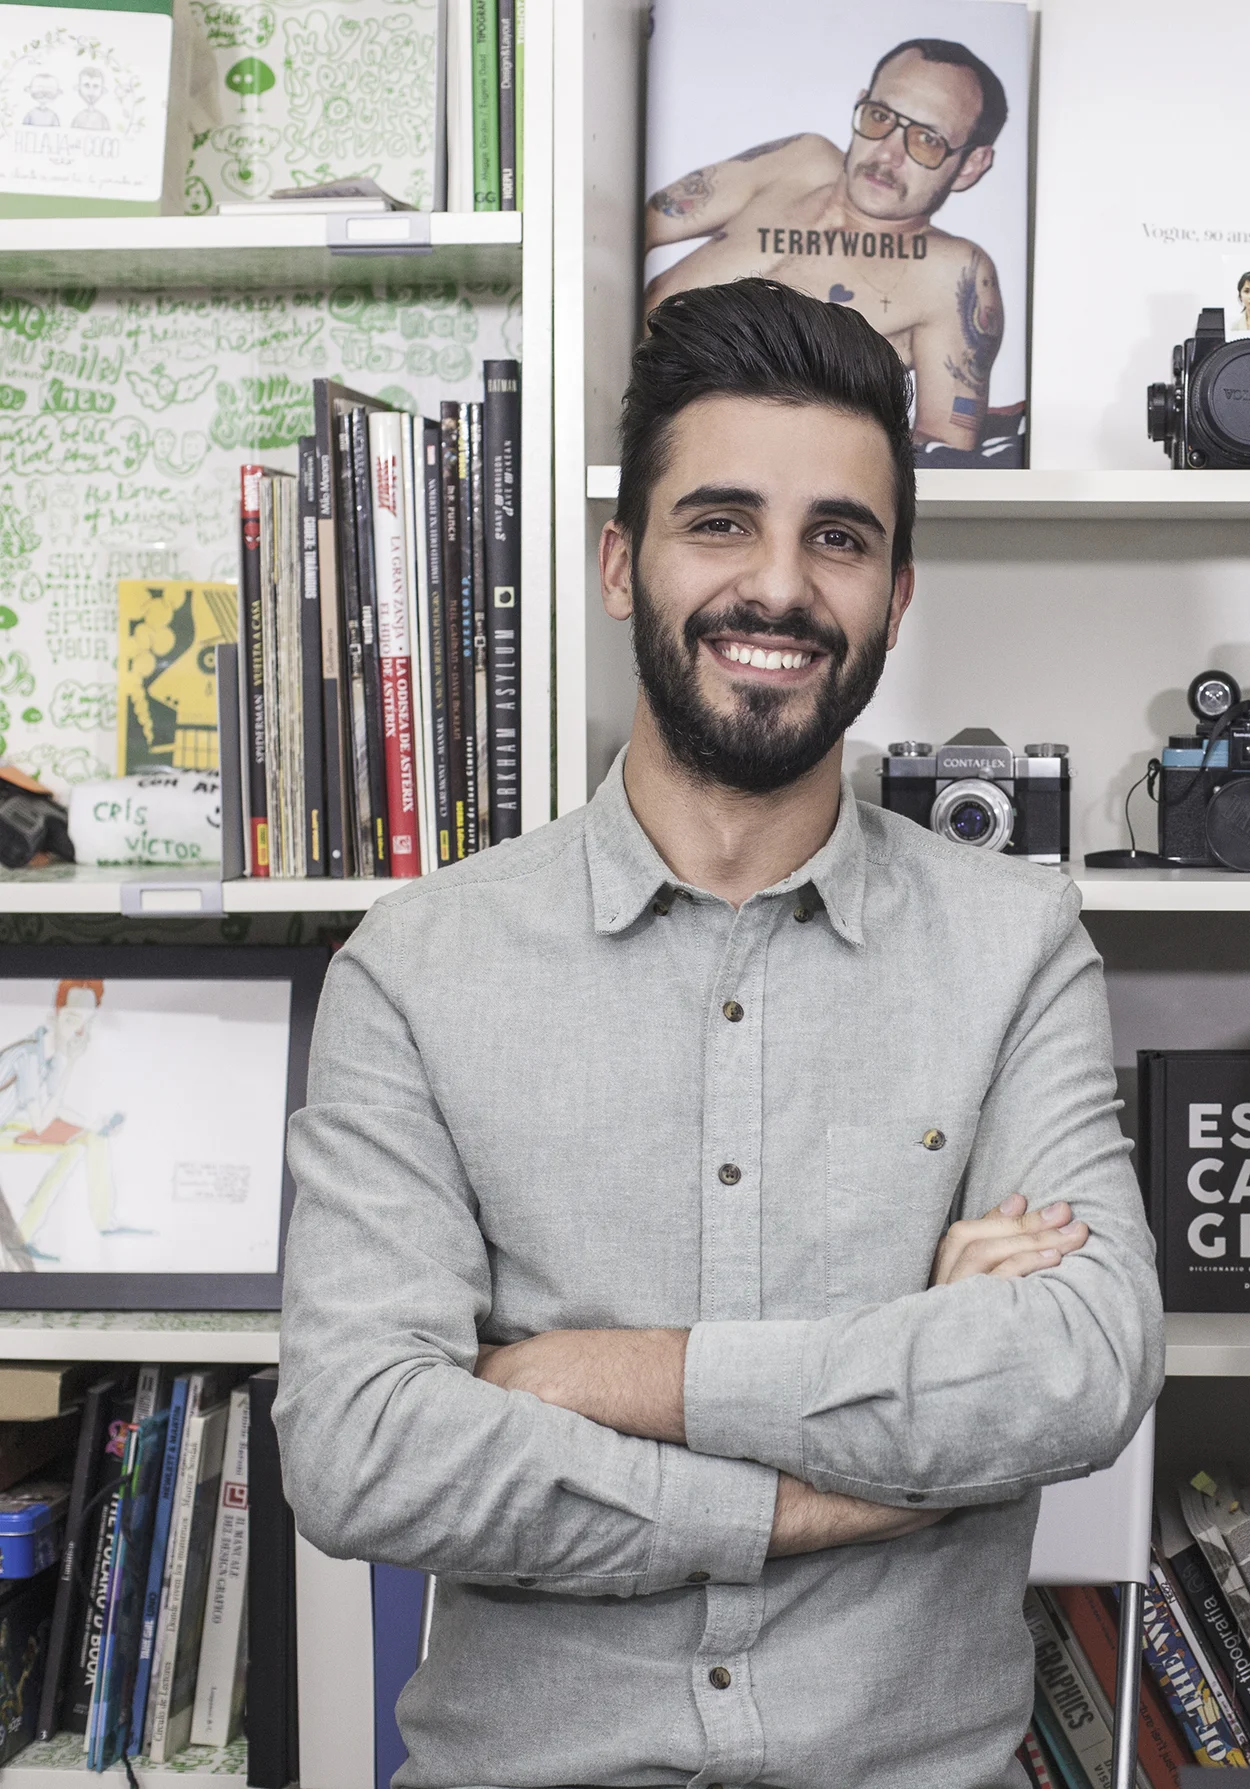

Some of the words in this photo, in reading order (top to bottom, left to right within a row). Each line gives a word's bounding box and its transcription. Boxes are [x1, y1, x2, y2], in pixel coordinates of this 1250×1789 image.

[474, 191, 497, 204] GG
[757, 227, 928, 260] TERRYWORLD
[487, 378, 517, 393] BATMAN
[320, 454, 331, 492] Manara
[320, 495, 331, 515] Milo
[447, 506, 456, 542] PUNCH
[391, 556, 402, 593] GRAN
[251, 599, 262, 631] CASA
[252, 641, 263, 687] VUELTA
[382, 658, 394, 676] DE
[395, 658, 408, 676] LA
[494, 629, 516, 710] ASYLUM
[396, 680, 411, 731] ODISEA
[254, 694, 266, 765] SPIDERMAN
[399, 732, 412, 751] DE
[495, 728, 518, 810] ARKHAM
[942, 757, 1006, 769] CONTAFLEX
[1161, 1652, 1204, 1718] THE
[1195, 1725, 1228, 1762] OF
